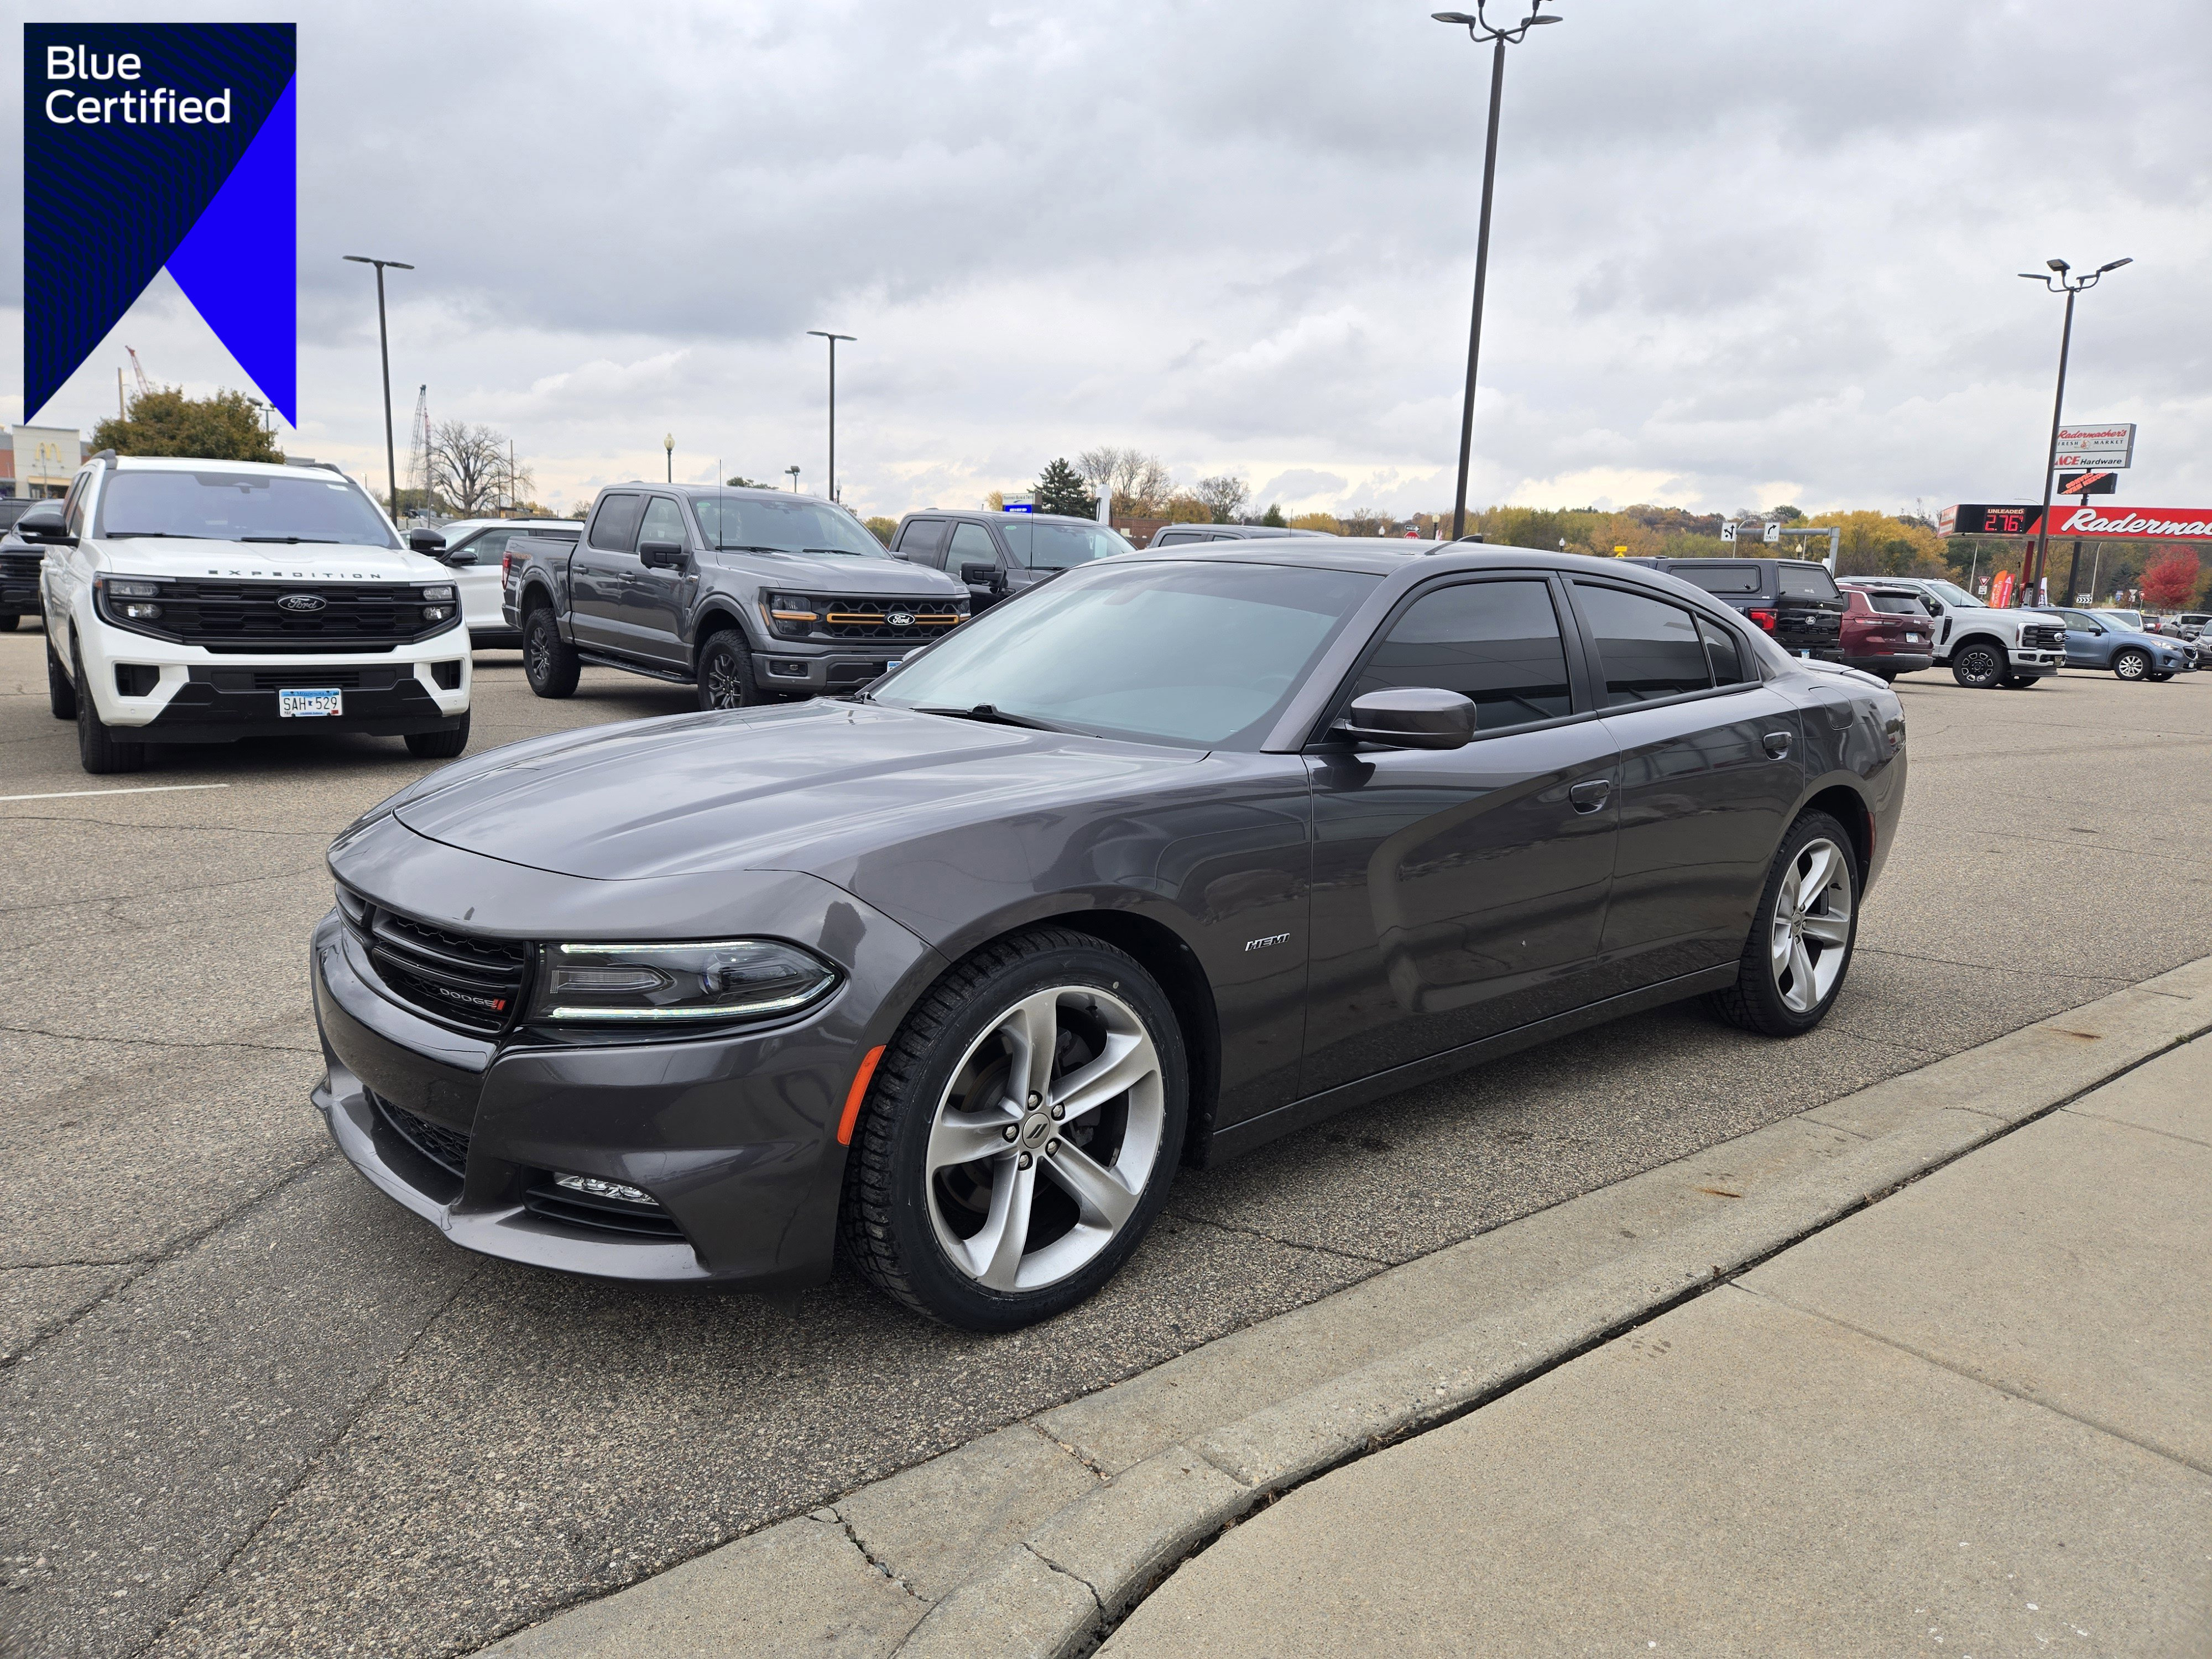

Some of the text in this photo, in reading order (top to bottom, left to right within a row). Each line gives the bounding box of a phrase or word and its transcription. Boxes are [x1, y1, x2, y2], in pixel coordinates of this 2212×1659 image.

[2058, 429, 2127, 439] Radermacher's
[2054, 455, 2080, 466] ACE
[208, 570, 381, 579] EXPEDITION
[288, 598, 316, 609] Ford
[893, 614, 910, 624] Ford
[284, 697, 337, 711] SAH 529
[1245, 932, 1290, 952] HEMI
[440, 988, 497, 1008] DODGE
